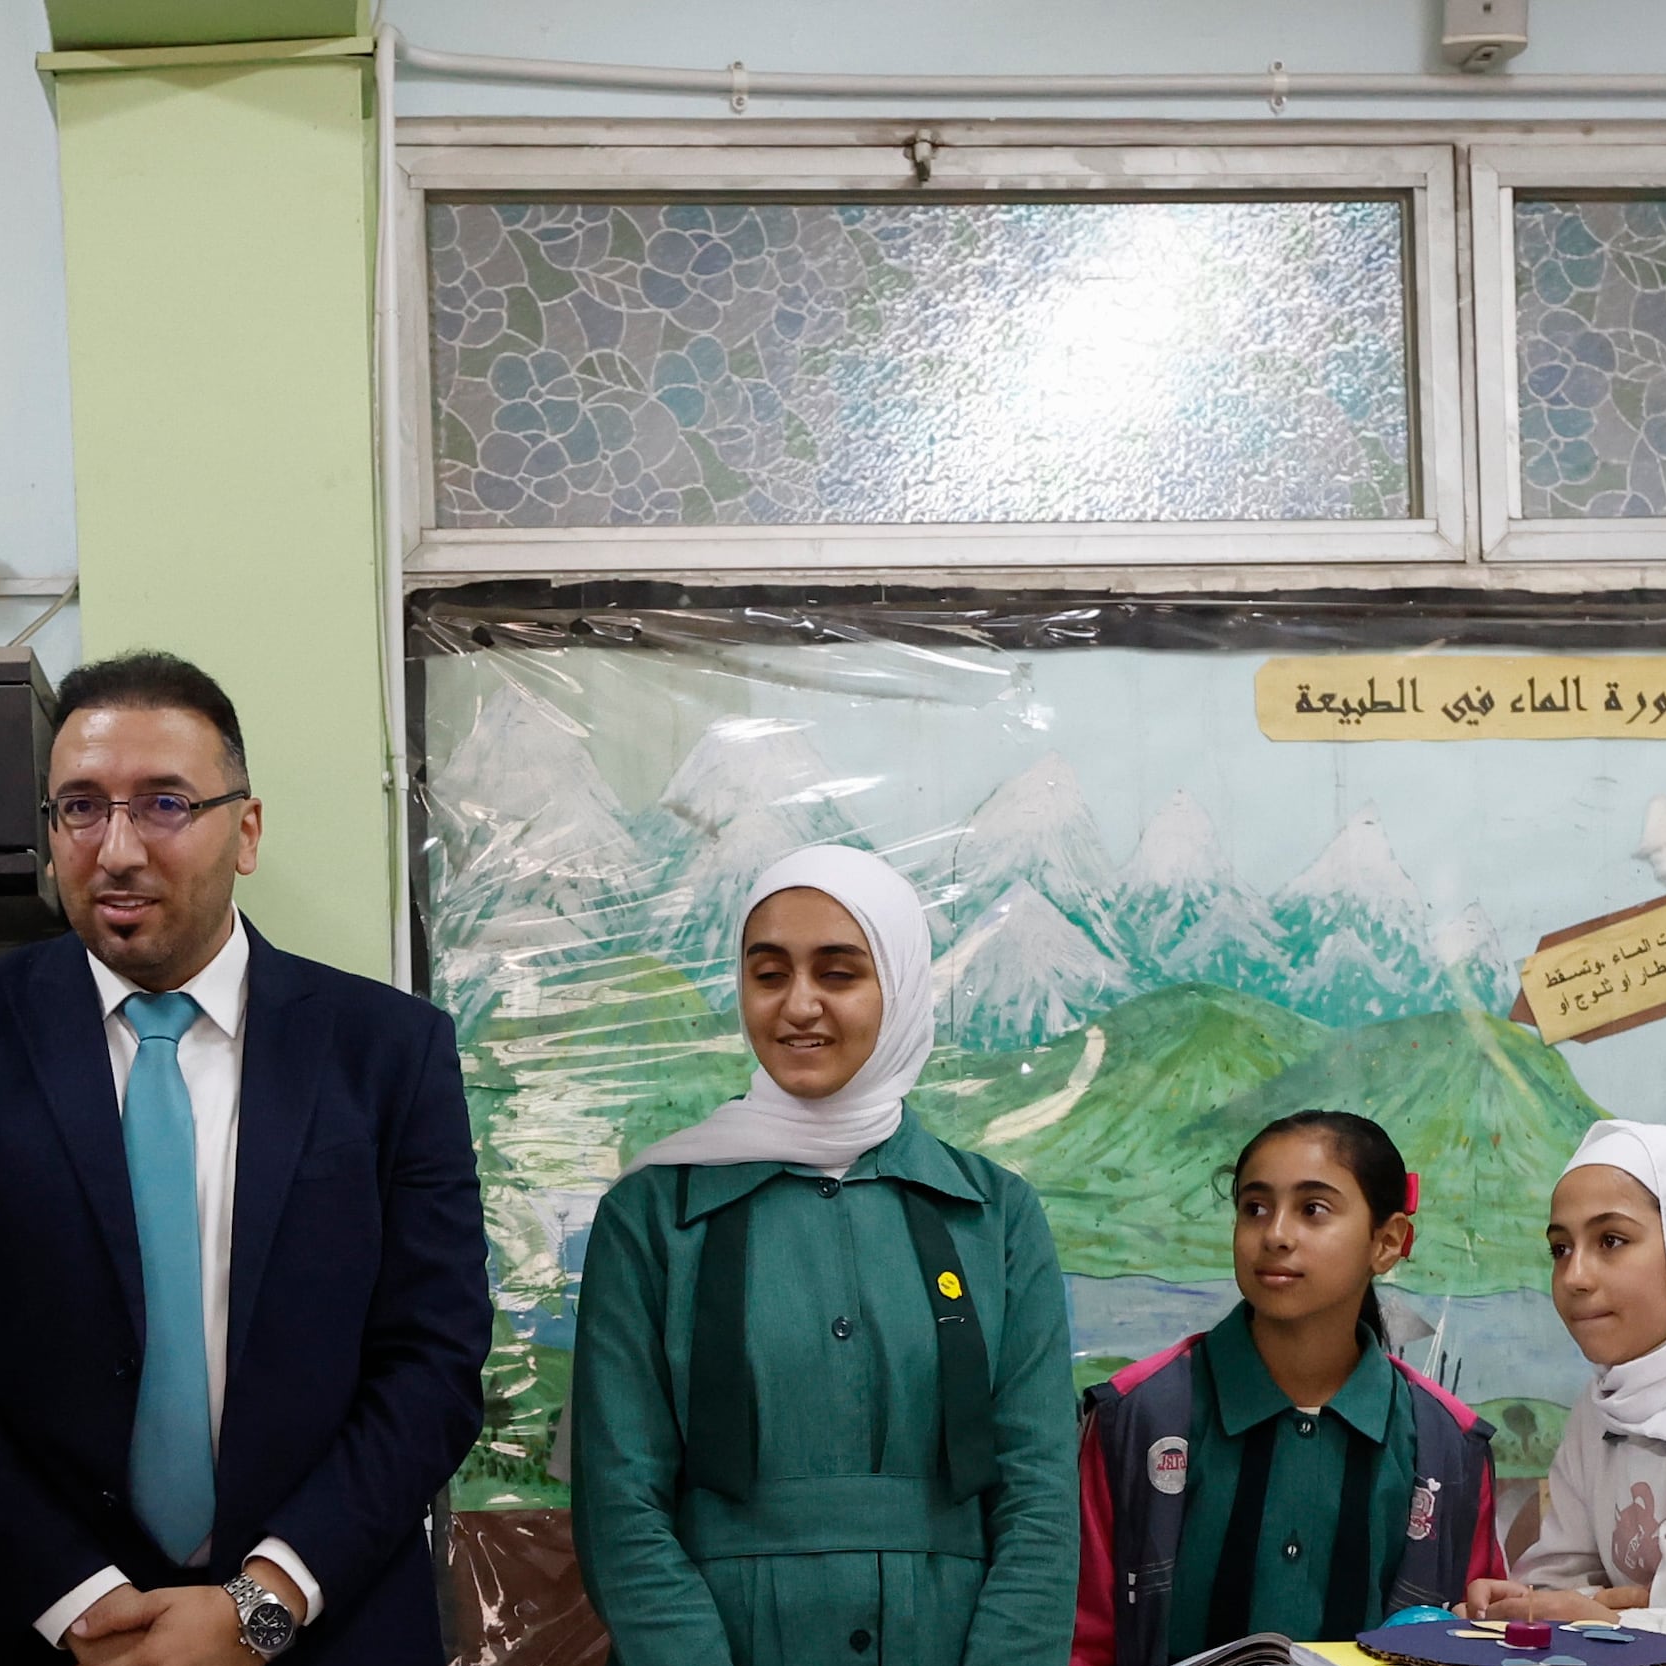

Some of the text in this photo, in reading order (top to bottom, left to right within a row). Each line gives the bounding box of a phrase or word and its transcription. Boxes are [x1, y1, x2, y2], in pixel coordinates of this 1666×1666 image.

[1294, 677, 1424, 725] الطبيعة
[1441, 685, 1496, 726] في
[1510, 675, 1587, 714] الماء
[1611, 938, 1652, 965] الماء
